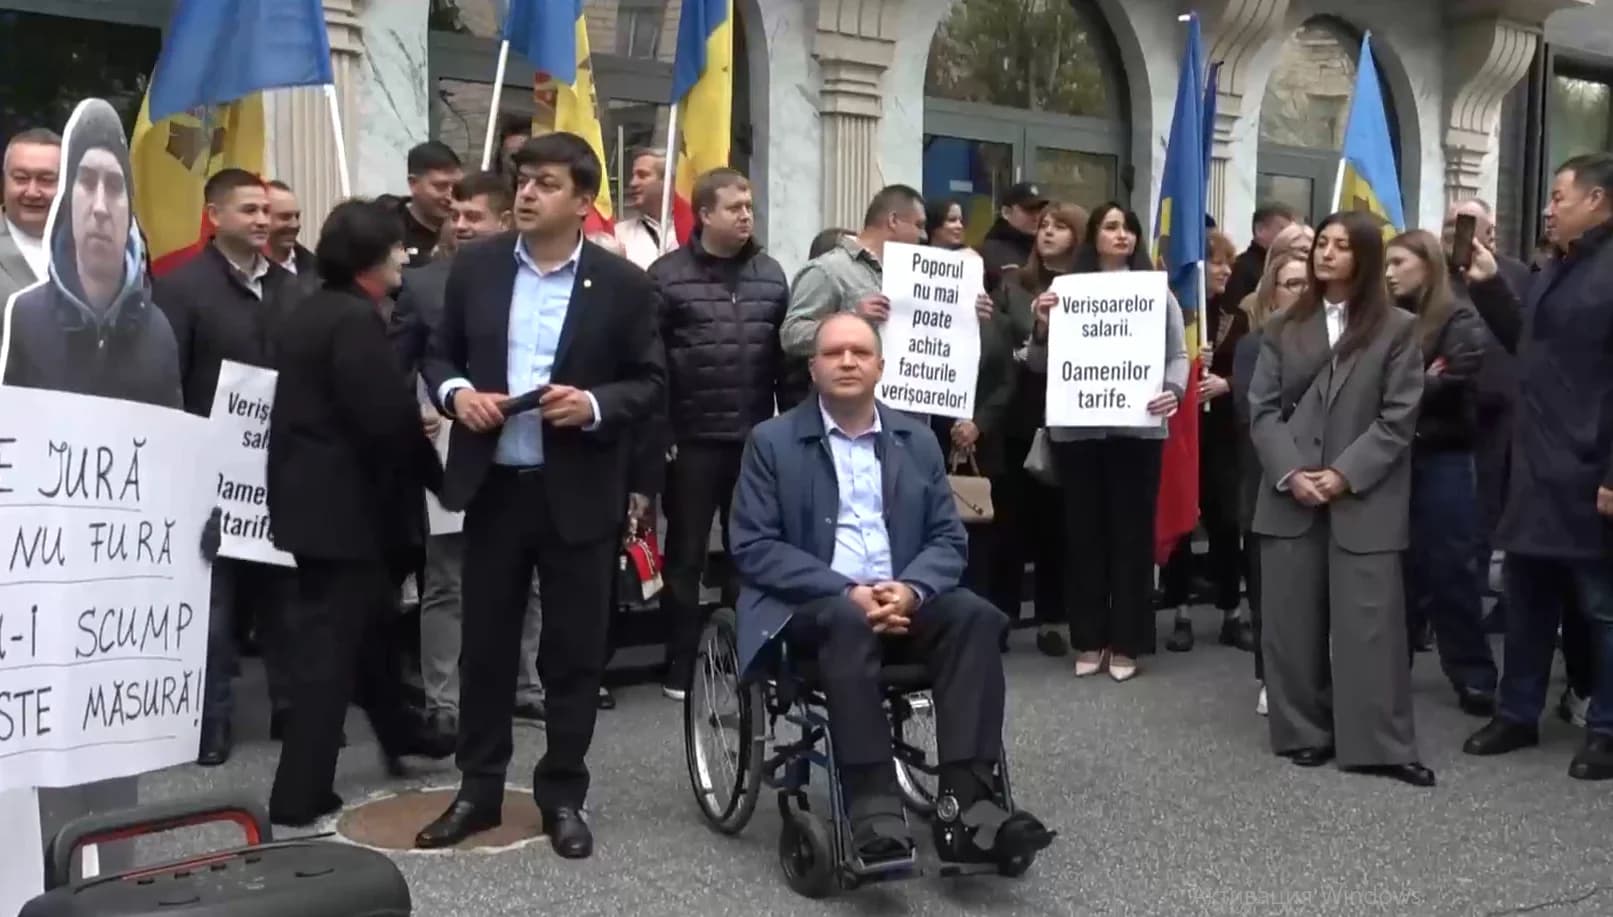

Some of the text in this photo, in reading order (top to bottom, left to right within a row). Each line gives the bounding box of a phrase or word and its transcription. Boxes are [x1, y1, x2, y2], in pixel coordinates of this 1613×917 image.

[912, 252, 964, 279] Poporul
[913, 283, 959, 305] nu mai
[1062, 294, 1155, 317] Verișoarelor
[912, 309, 952, 330] poate
[1082, 318, 1133, 338] salarii.
[908, 337, 951, 358] achita
[898, 357, 957, 383] facturile
[1062, 360, 1151, 382] Oamenilor
[228, 391, 271, 425] Veriș
[881, 383, 968, 410] verișoarelor!
[1078, 387, 1131, 409] tarife.
[242, 429, 270, 450] sal
[38, 436, 147, 502] JURĂ
[9, 517, 176, 573] NU FURĂ
[75, 602, 193, 659] SCUMP
[83, 667, 201, 741] MĂSURĂ!
